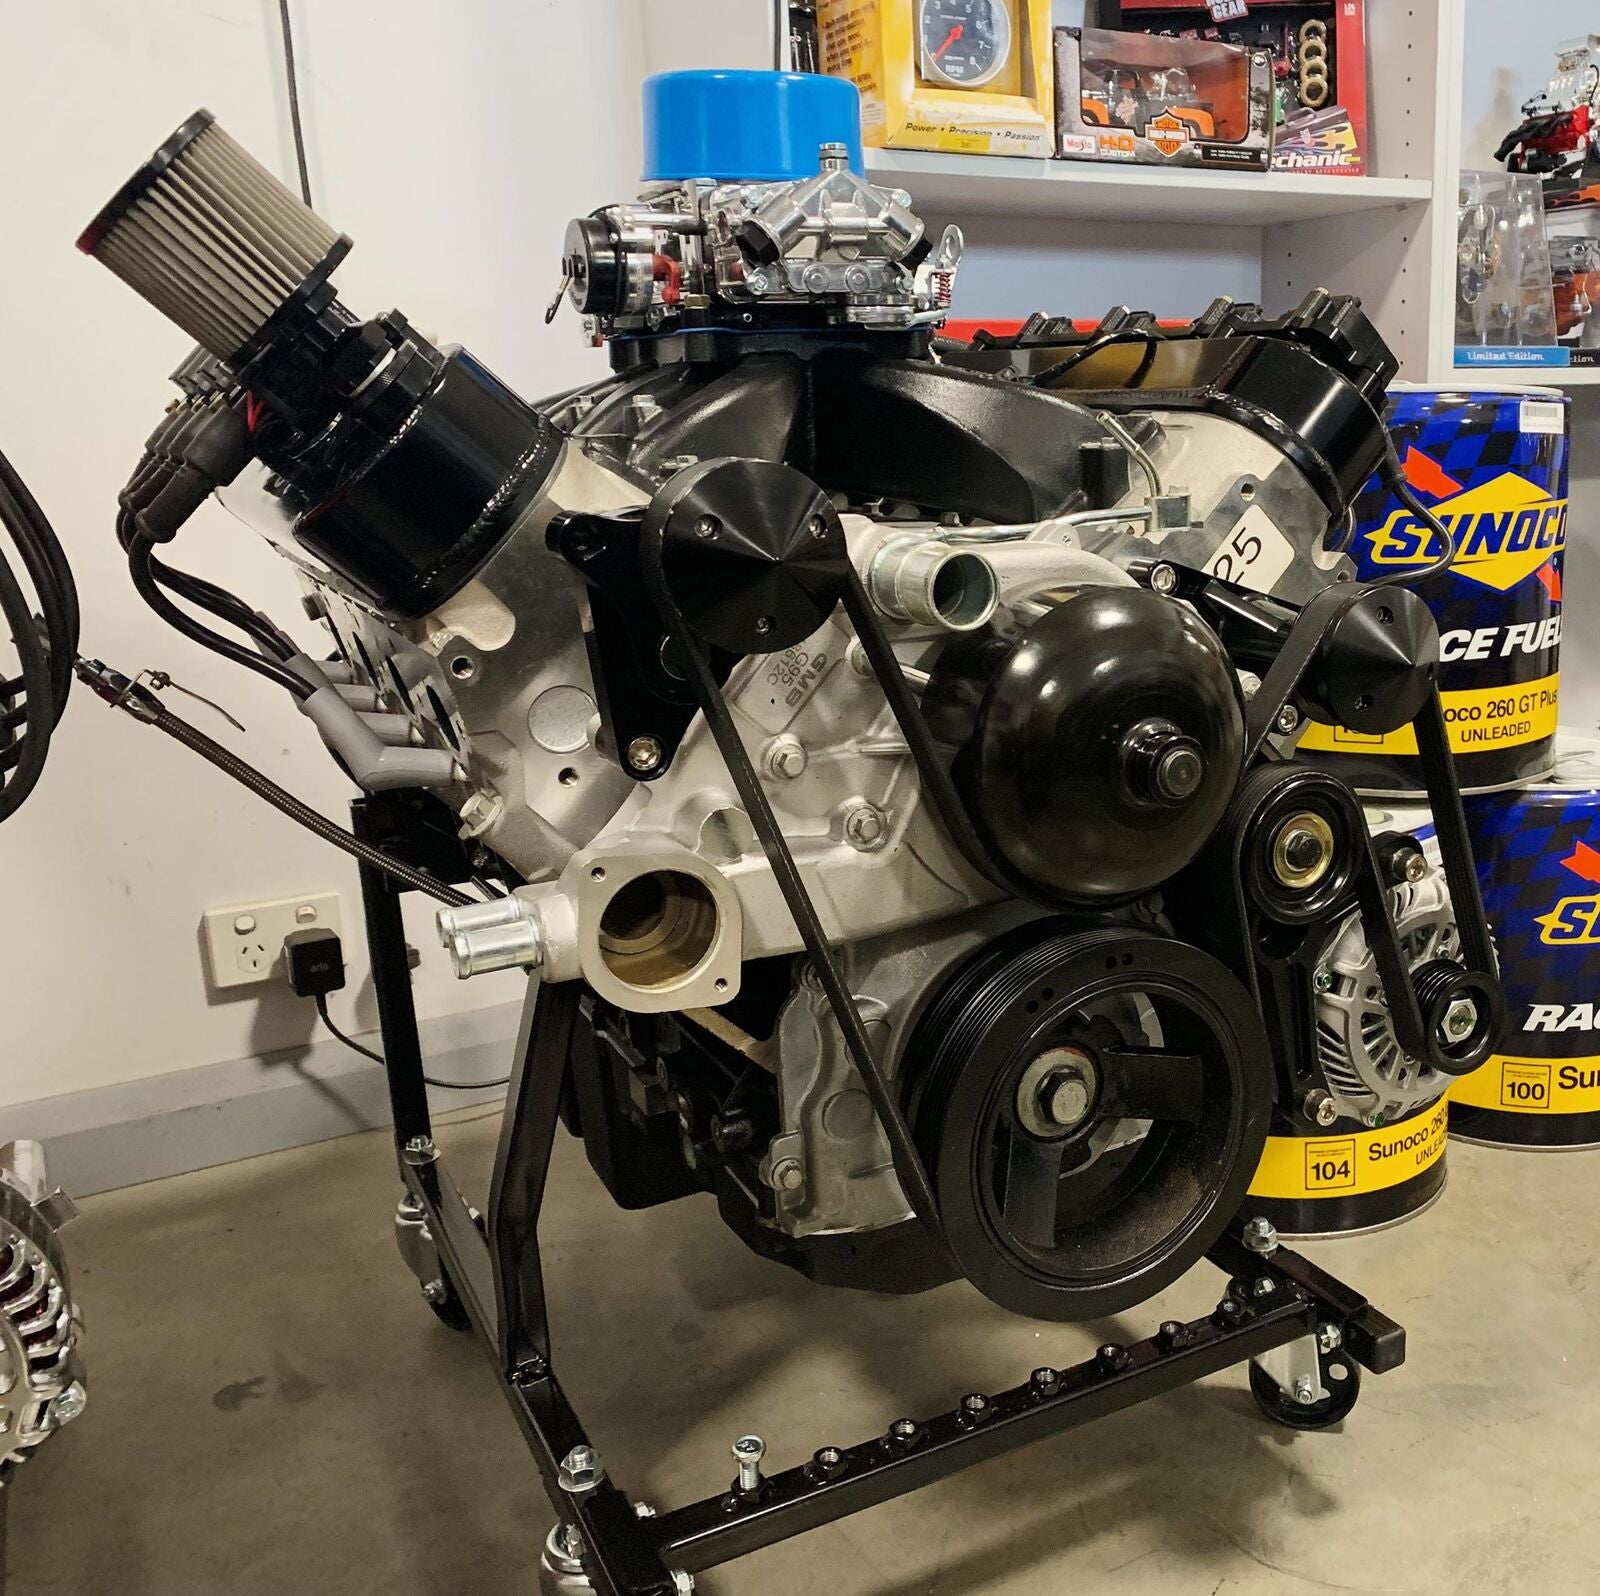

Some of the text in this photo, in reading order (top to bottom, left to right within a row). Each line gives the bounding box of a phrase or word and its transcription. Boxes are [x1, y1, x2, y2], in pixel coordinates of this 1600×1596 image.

[965, 4, 972, 13] 5
[975, 20, 983, 30] 6
[978, 40, 985, 49] 7
[945, 64, 964, 74] RPM
[969, 56, 976, 65] 8
[905, 122, 1041, 141] Power Precision Passion
[1467, 351, 1545, 361] Limited Edition
[1500, 615, 1562, 657] FUEL
[785, 653, 827, 707] GMB
[1486, 698, 1516, 719] 260
[1519, 693, 1539, 714] GT
[1540, 688, 1559, 709] Plus
[1461, 721, 1532, 743] UNLEADED
[1522, 1003, 1600, 1032] RA
[1558, 1066, 1600, 1090] Su
[1506, 1081, 1545, 1101] 100
[1369, 1127, 1429, 1161] Sunoco
[1311, 1160, 1351, 1181] 104
